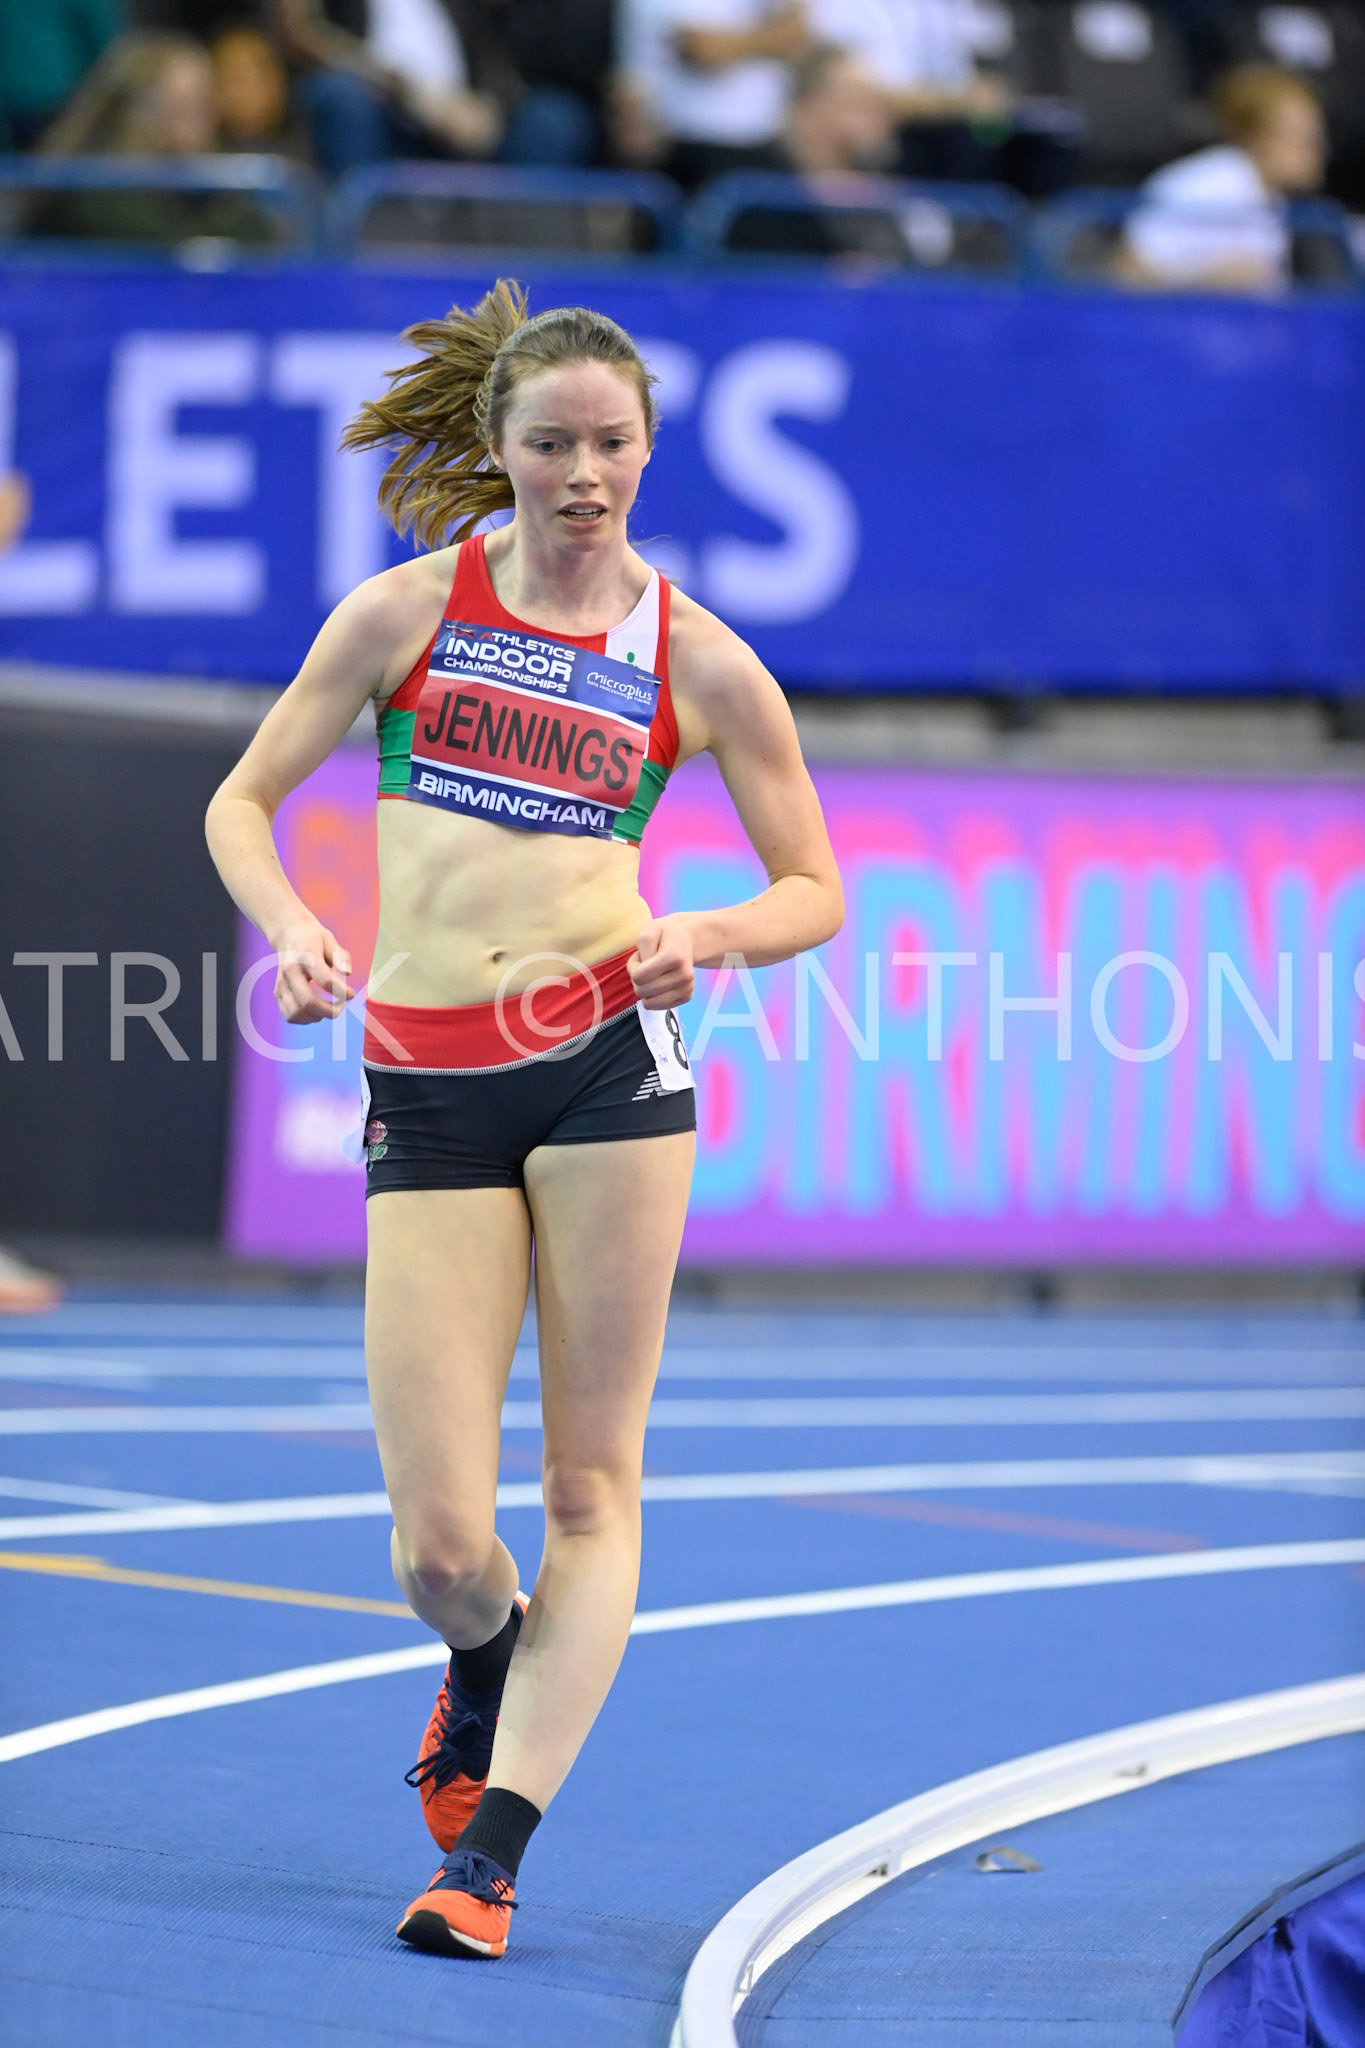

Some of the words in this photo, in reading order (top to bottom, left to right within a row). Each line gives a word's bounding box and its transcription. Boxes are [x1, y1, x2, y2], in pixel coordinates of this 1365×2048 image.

[445, 637, 573, 682] INDOOR
[479, 631, 577, 662] ATHLETICS
[443, 657, 568, 694] CHAMPIONSHIPS
[424, 691, 632, 791] JENNINGS
[418, 772, 606, 828] BIRMINGHAM
